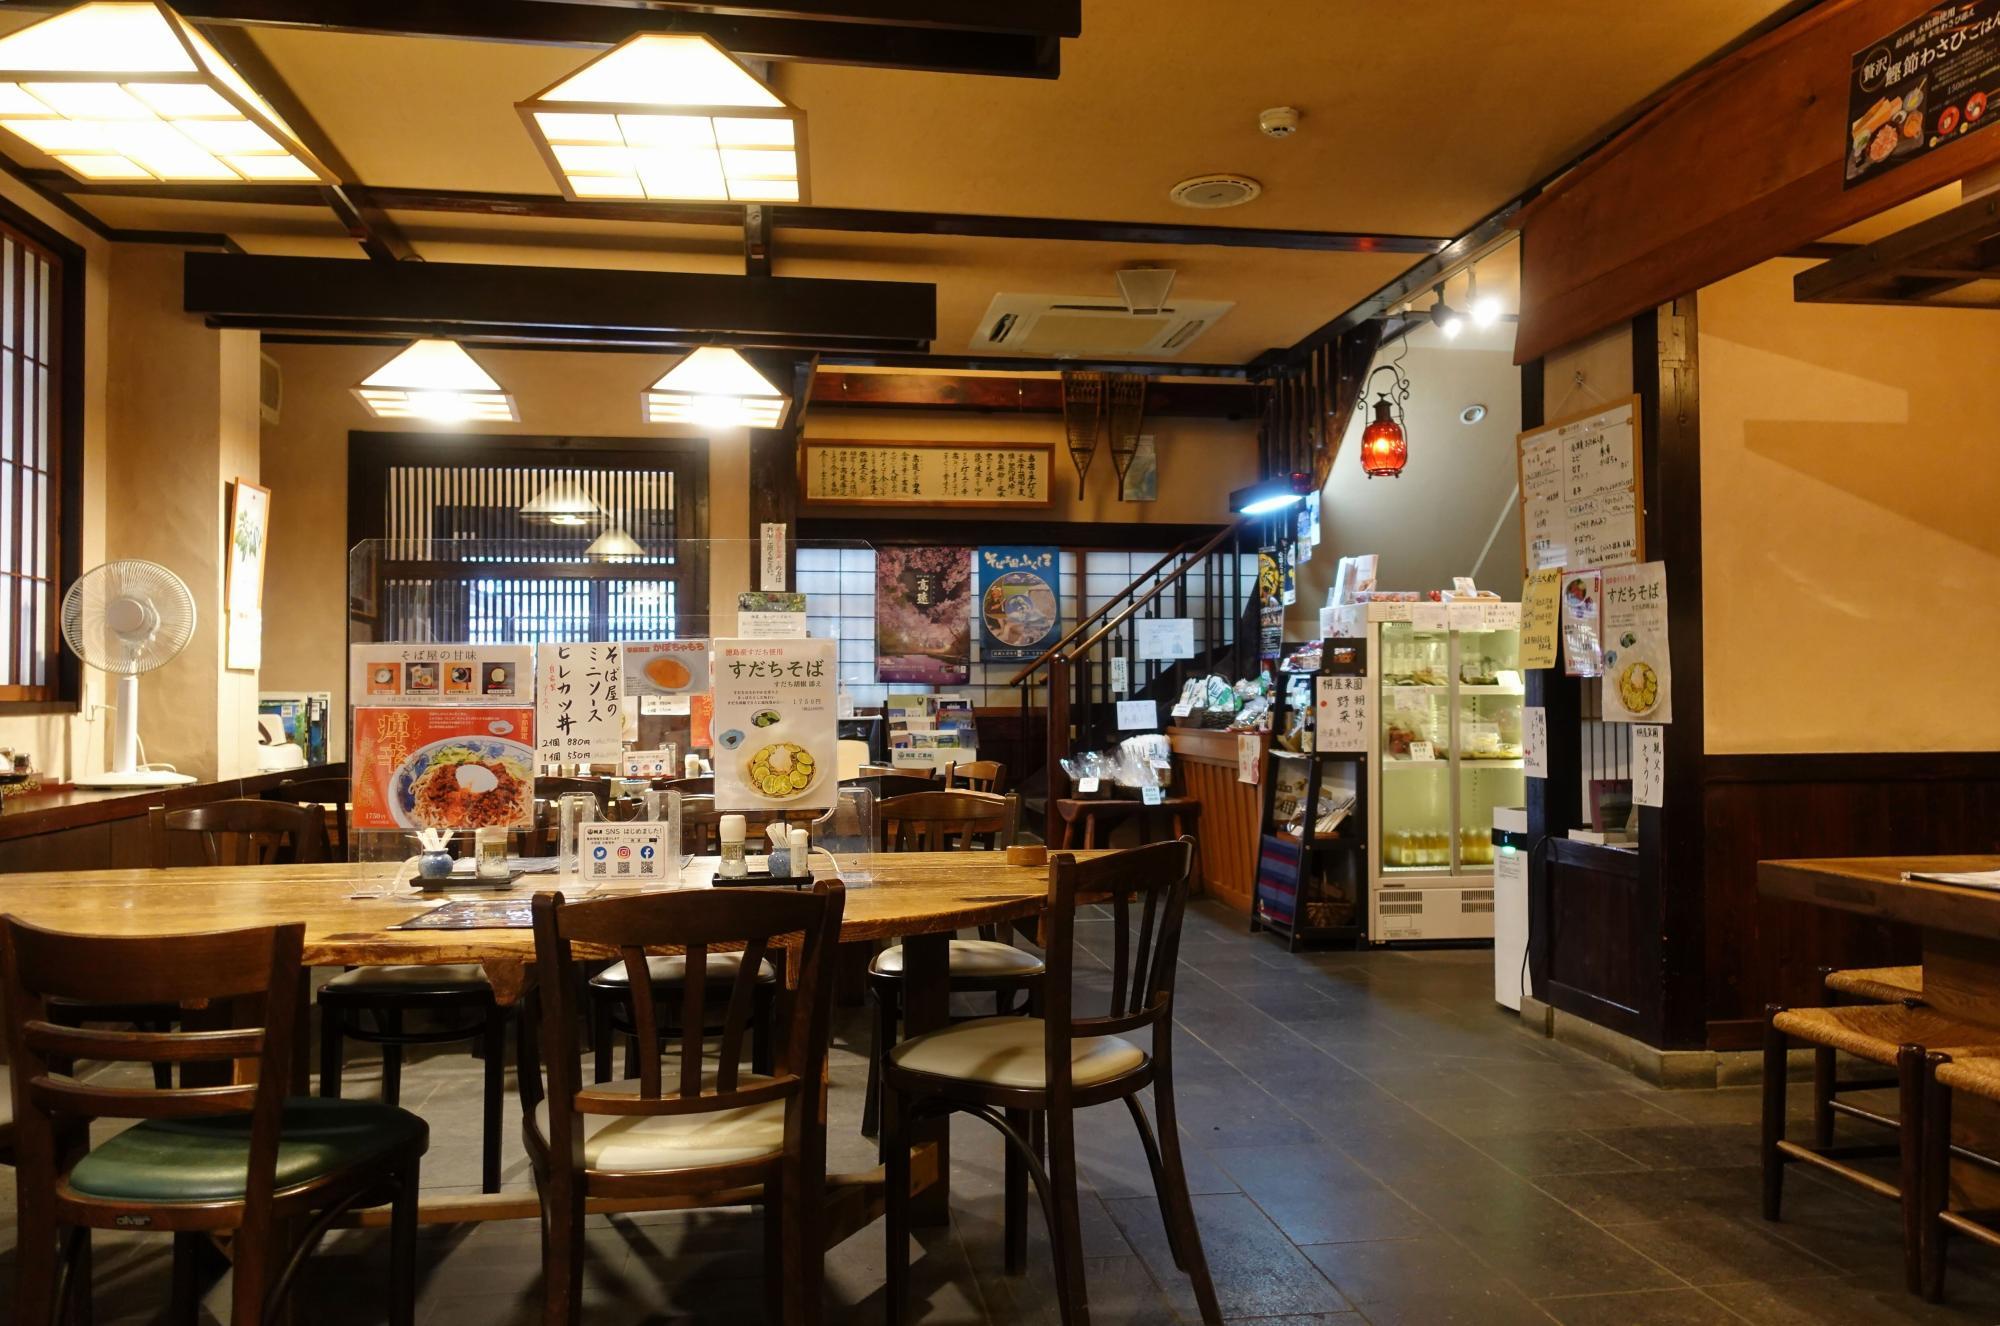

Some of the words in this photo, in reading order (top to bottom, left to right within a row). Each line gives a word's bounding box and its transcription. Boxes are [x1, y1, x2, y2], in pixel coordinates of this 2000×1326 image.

[1607, 582, 1659, 604] すだちそば
[400, 650, 477, 661] そば屋の甘味
[653, 642, 705, 653] かぼちゃもち
[728, 659, 825, 680] すだちそば
[586, 647, 602, 723] ミニソース
[605, 645, 619, 717] そば屋の
[542, 738, 560, 748] 2個
[566, 738, 591, 746] 880円
[543, 752, 561, 762] 1個
[567, 751, 591, 760] 550円
